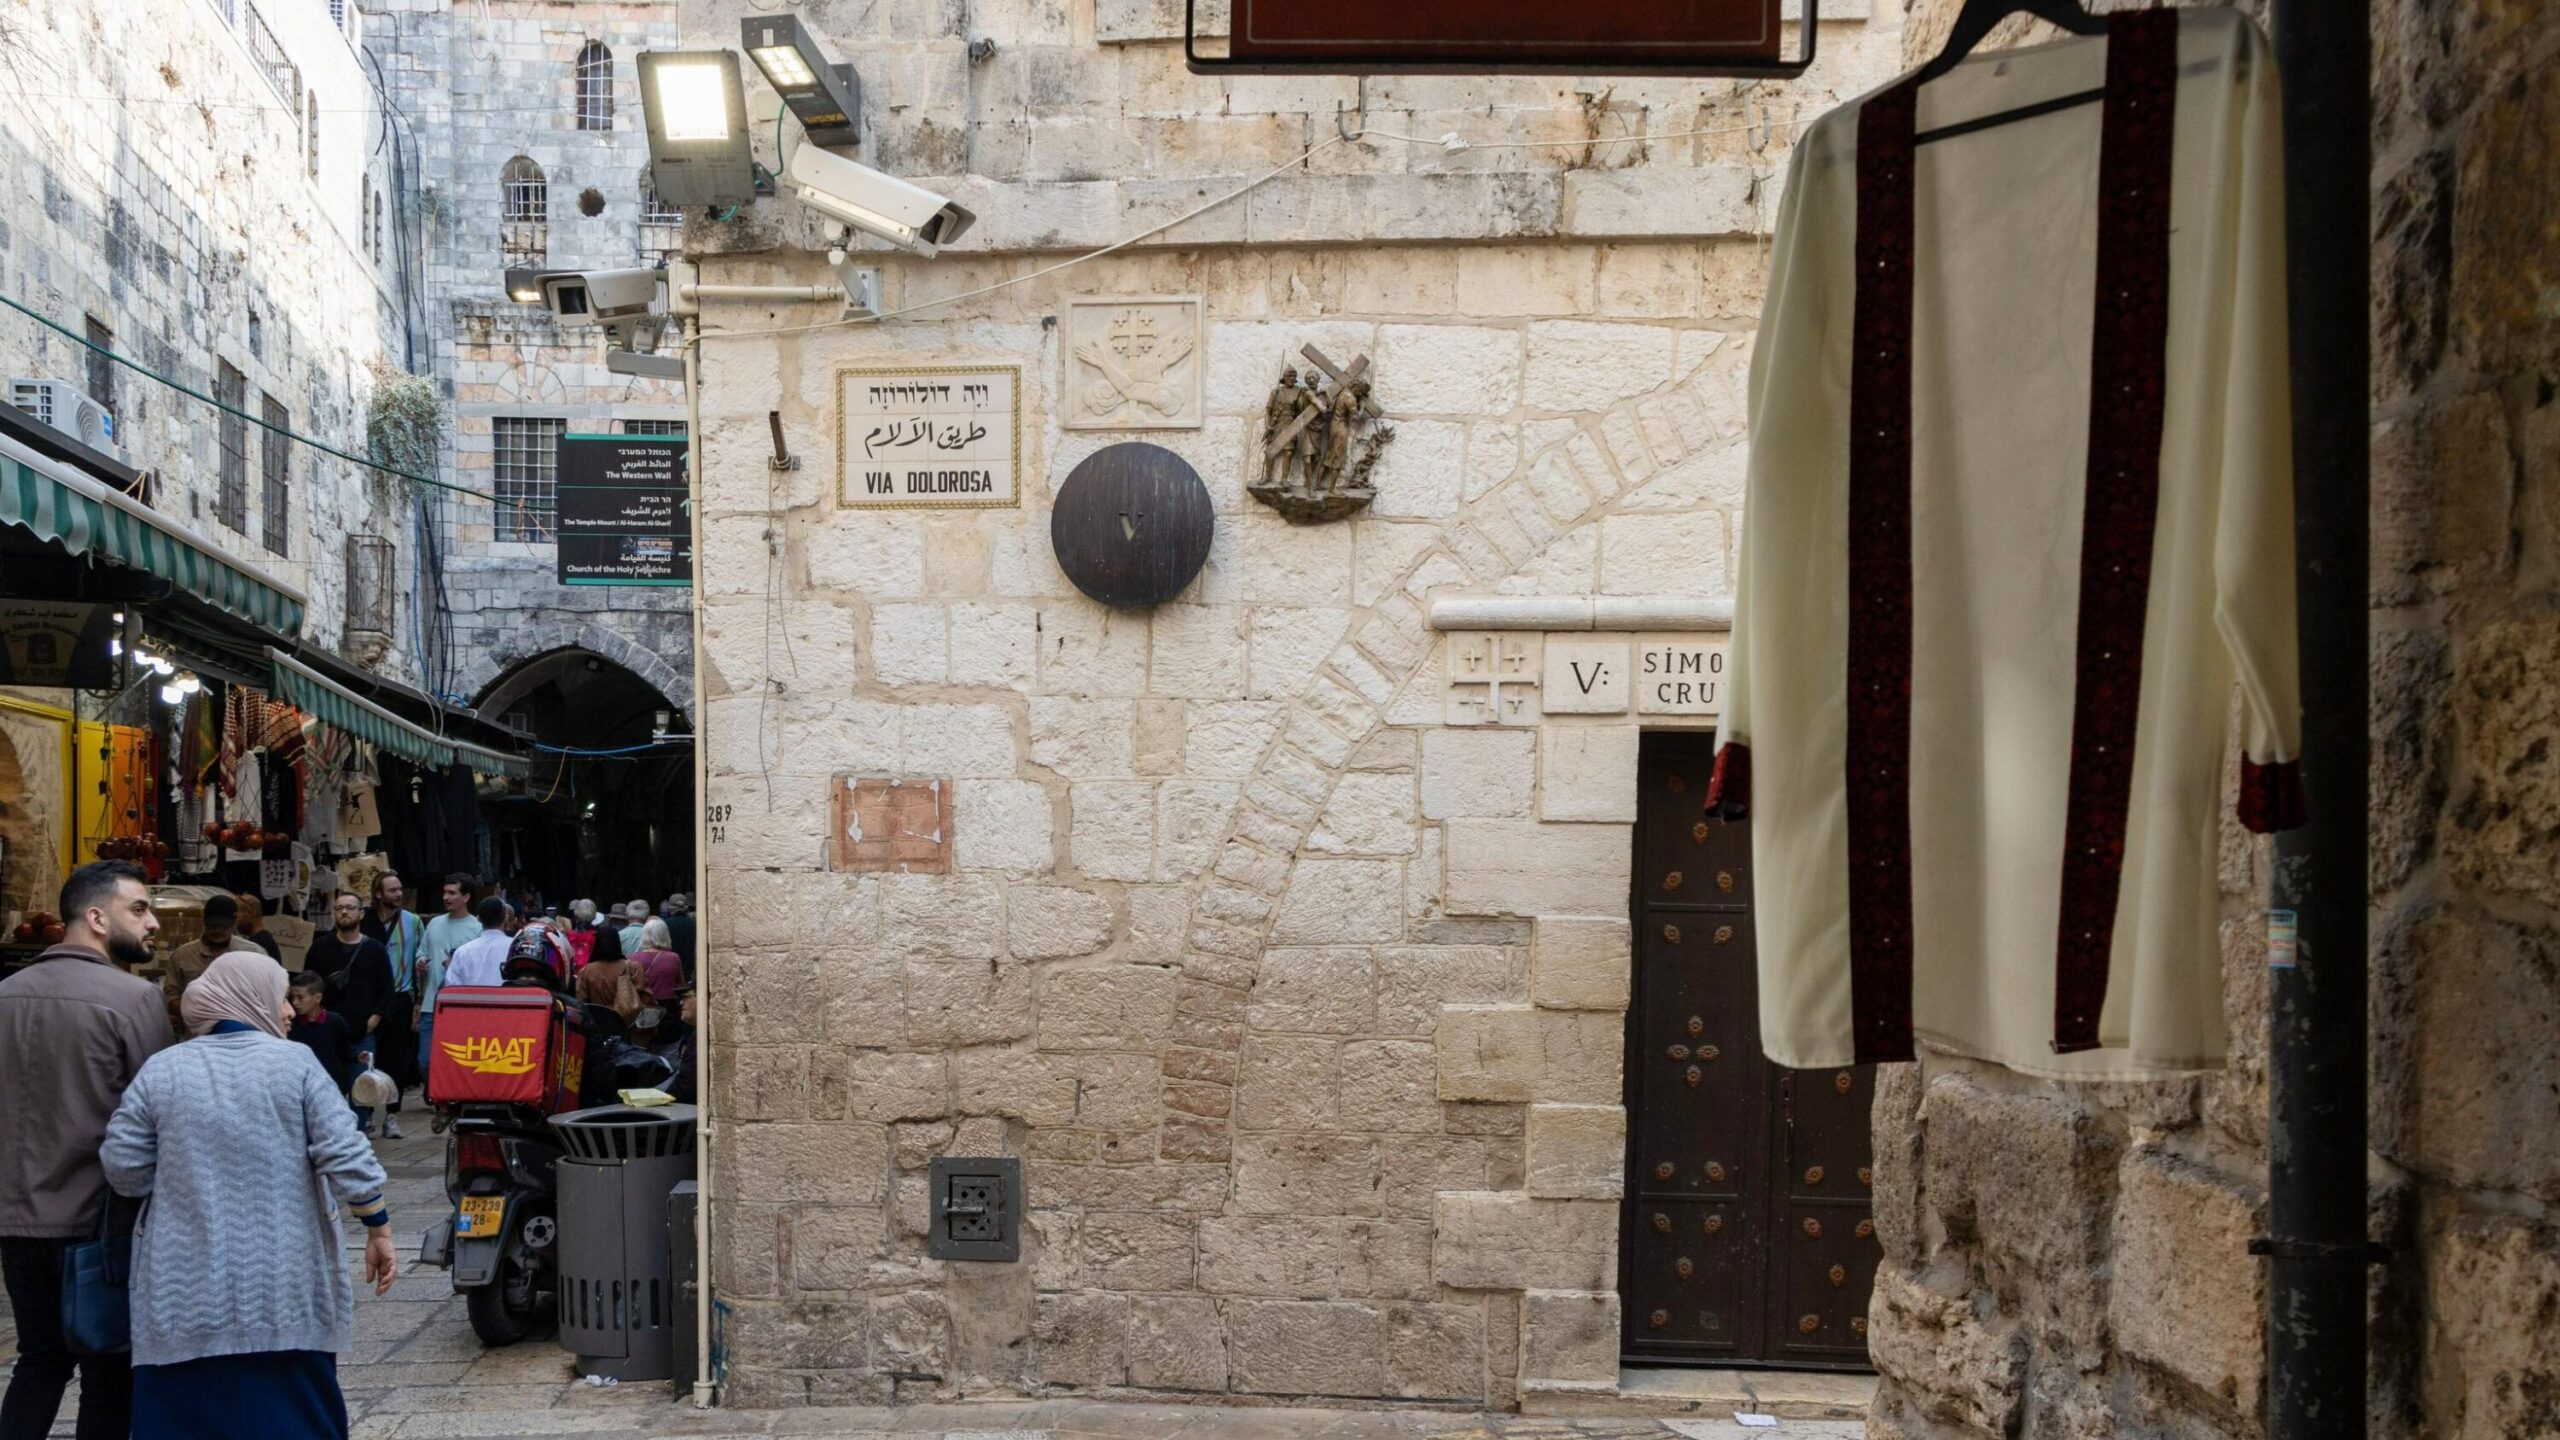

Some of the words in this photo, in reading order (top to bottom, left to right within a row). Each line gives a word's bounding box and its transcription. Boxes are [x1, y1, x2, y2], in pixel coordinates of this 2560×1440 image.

[936, 420, 987, 450] طريق
[617, 448, 647, 456] המערבי
[647, 448, 672, 456] הכותל
[648, 459, 672, 468] الحائط
[605, 471, 620, 479] The
[621, 471, 654, 479] Western
[654, 471, 672, 480] Wall
[865, 471, 894, 494] VIA
[907, 470, 993, 494] DOLOROSA
[621, 505, 651, 517] الشريف
[576, 519, 596, 528] Temple
[597, 519, 616, 527] Mount
[1118, 511, 1144, 541] V
[620, 553, 647, 564] القيامة
[647, 553, 672, 564] كنيسة
[566, 564, 593, 573] Church
[594, 565, 602, 573] of
[602, 564, 616, 573] the
[616, 564, 634, 575] Holy
[707, 804, 732, 822] 289
[465, 1036, 537, 1067] HAAT
